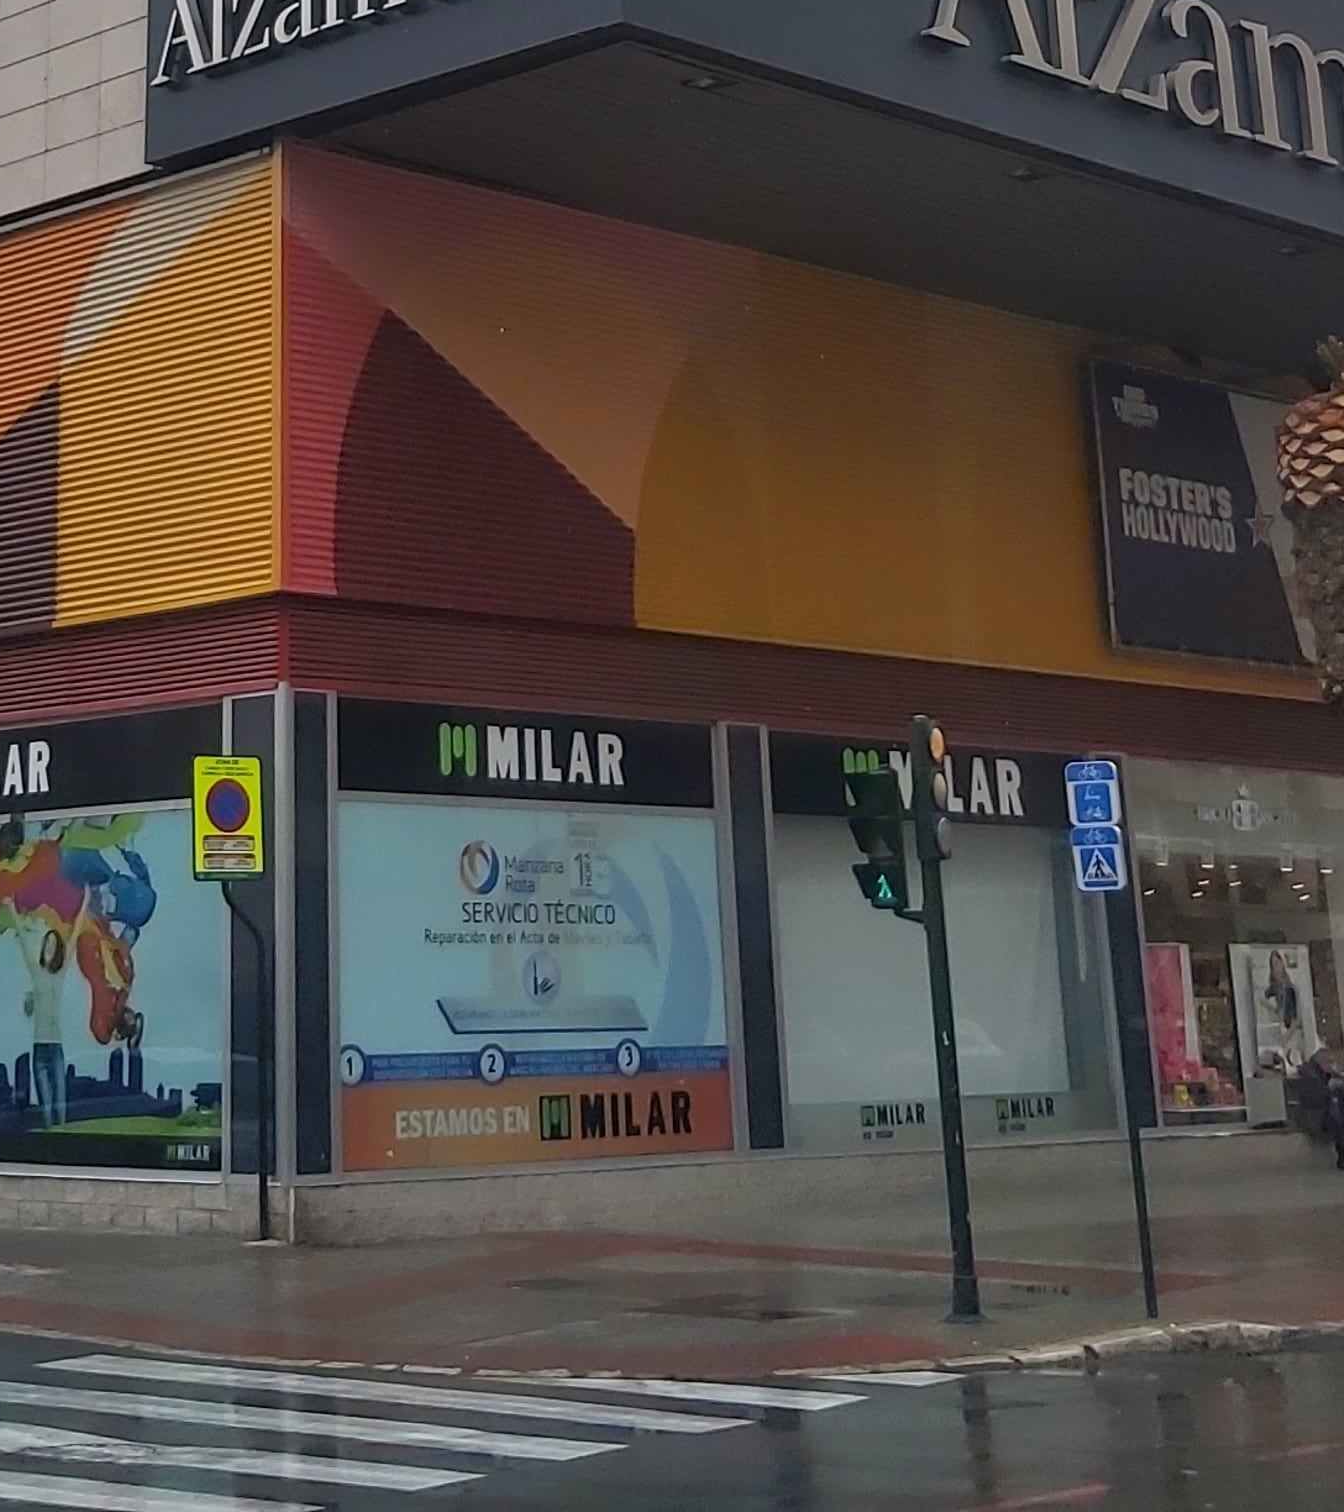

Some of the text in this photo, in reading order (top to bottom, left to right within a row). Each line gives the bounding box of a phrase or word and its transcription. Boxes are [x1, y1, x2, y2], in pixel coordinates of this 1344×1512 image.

[1118, 467, 1233, 519] FOSTER'S
[1121, 501, 1237, 553] HOLLYWOOD
[486, 724, 625, 786] MILAR
[888, 750, 1024, 816] MLAR
[462, 899, 616, 925] SERVICIO TÉCNICO
[424, 928, 487, 946] Reparación
[489, 933, 504, 944] en
[506, 932, 516, 944] el
[547, 931, 561, 945] de
[345, 1056, 354, 1076] 1
[487, 1054, 496, 1073] 2
[624, 1045, 633, 1068] 3
[395, 1091, 693, 1140] ESTAMOS EN MILAR
[875, 1103, 926, 1126] MILAR
[1010, 1097, 1056, 1119] MILAR
[177, 1144, 211, 1161] MILAR
